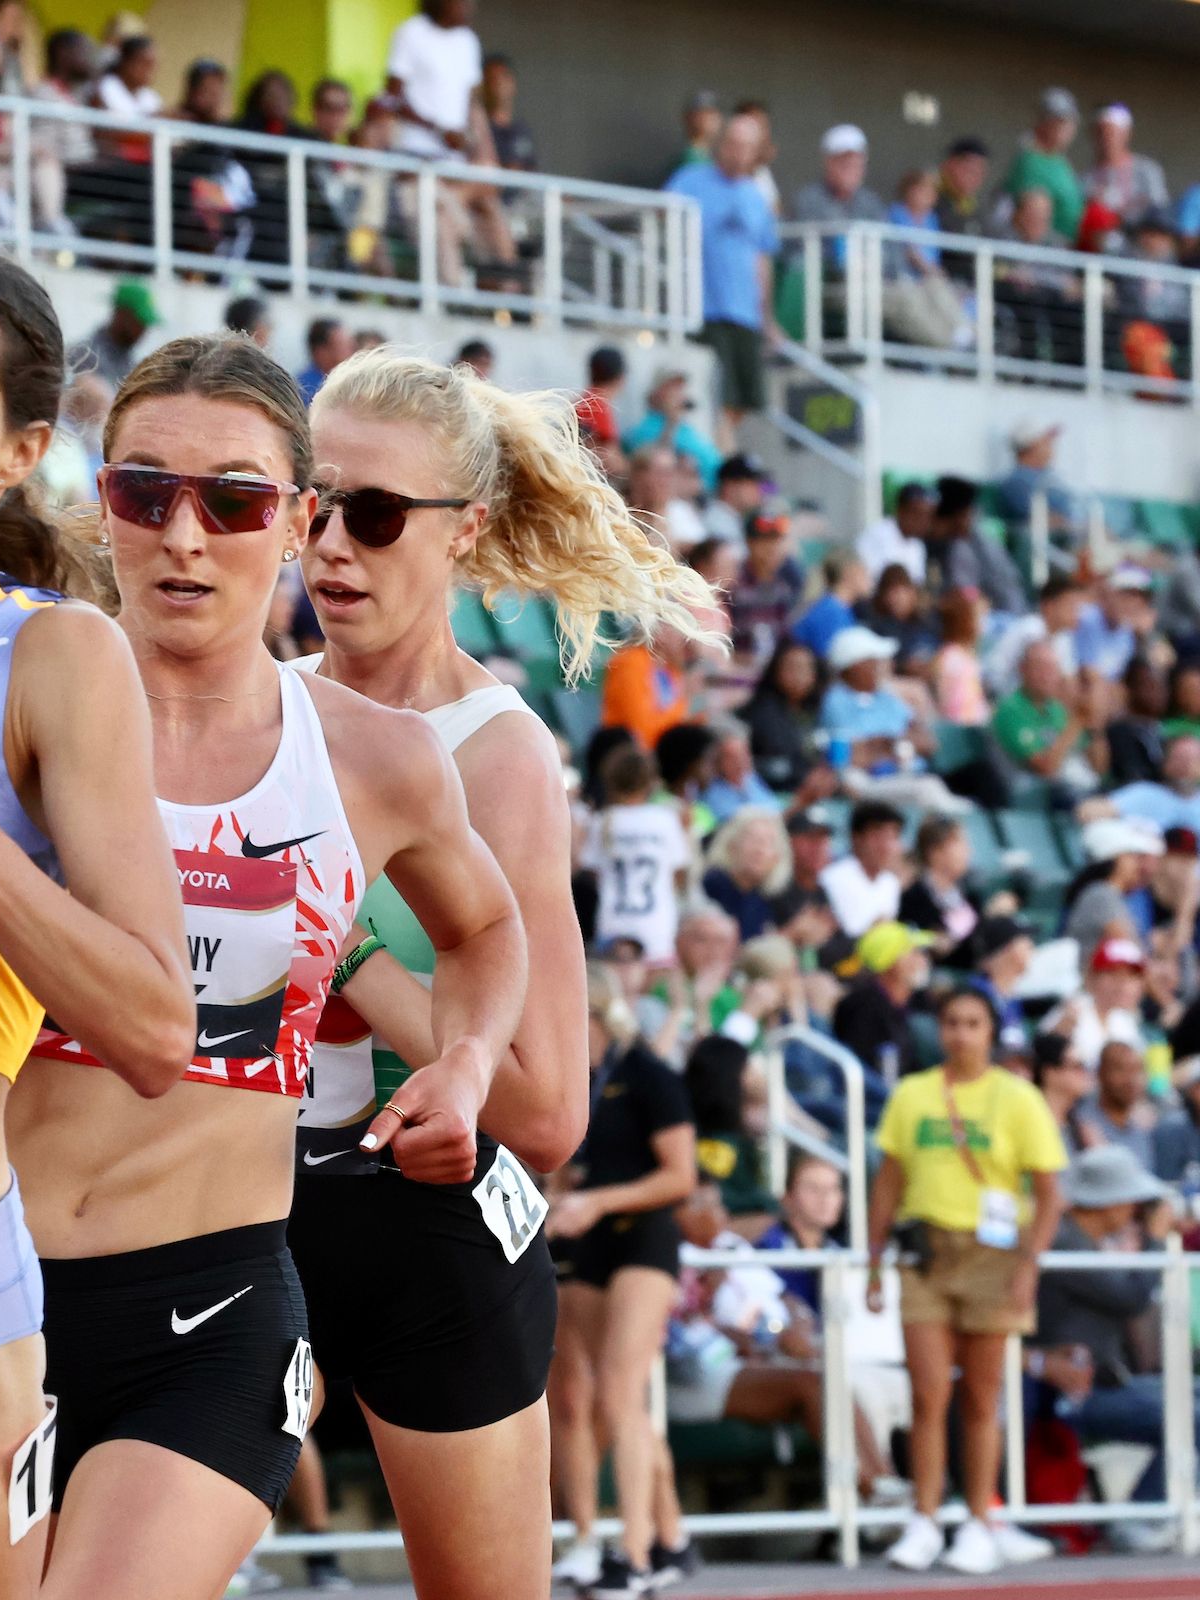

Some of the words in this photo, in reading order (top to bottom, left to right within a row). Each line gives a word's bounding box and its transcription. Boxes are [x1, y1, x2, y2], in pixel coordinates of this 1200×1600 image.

[177, 869, 231, 891] YOTA
[614, 857, 657, 915] 13
[486, 1154, 542, 1251] 22
